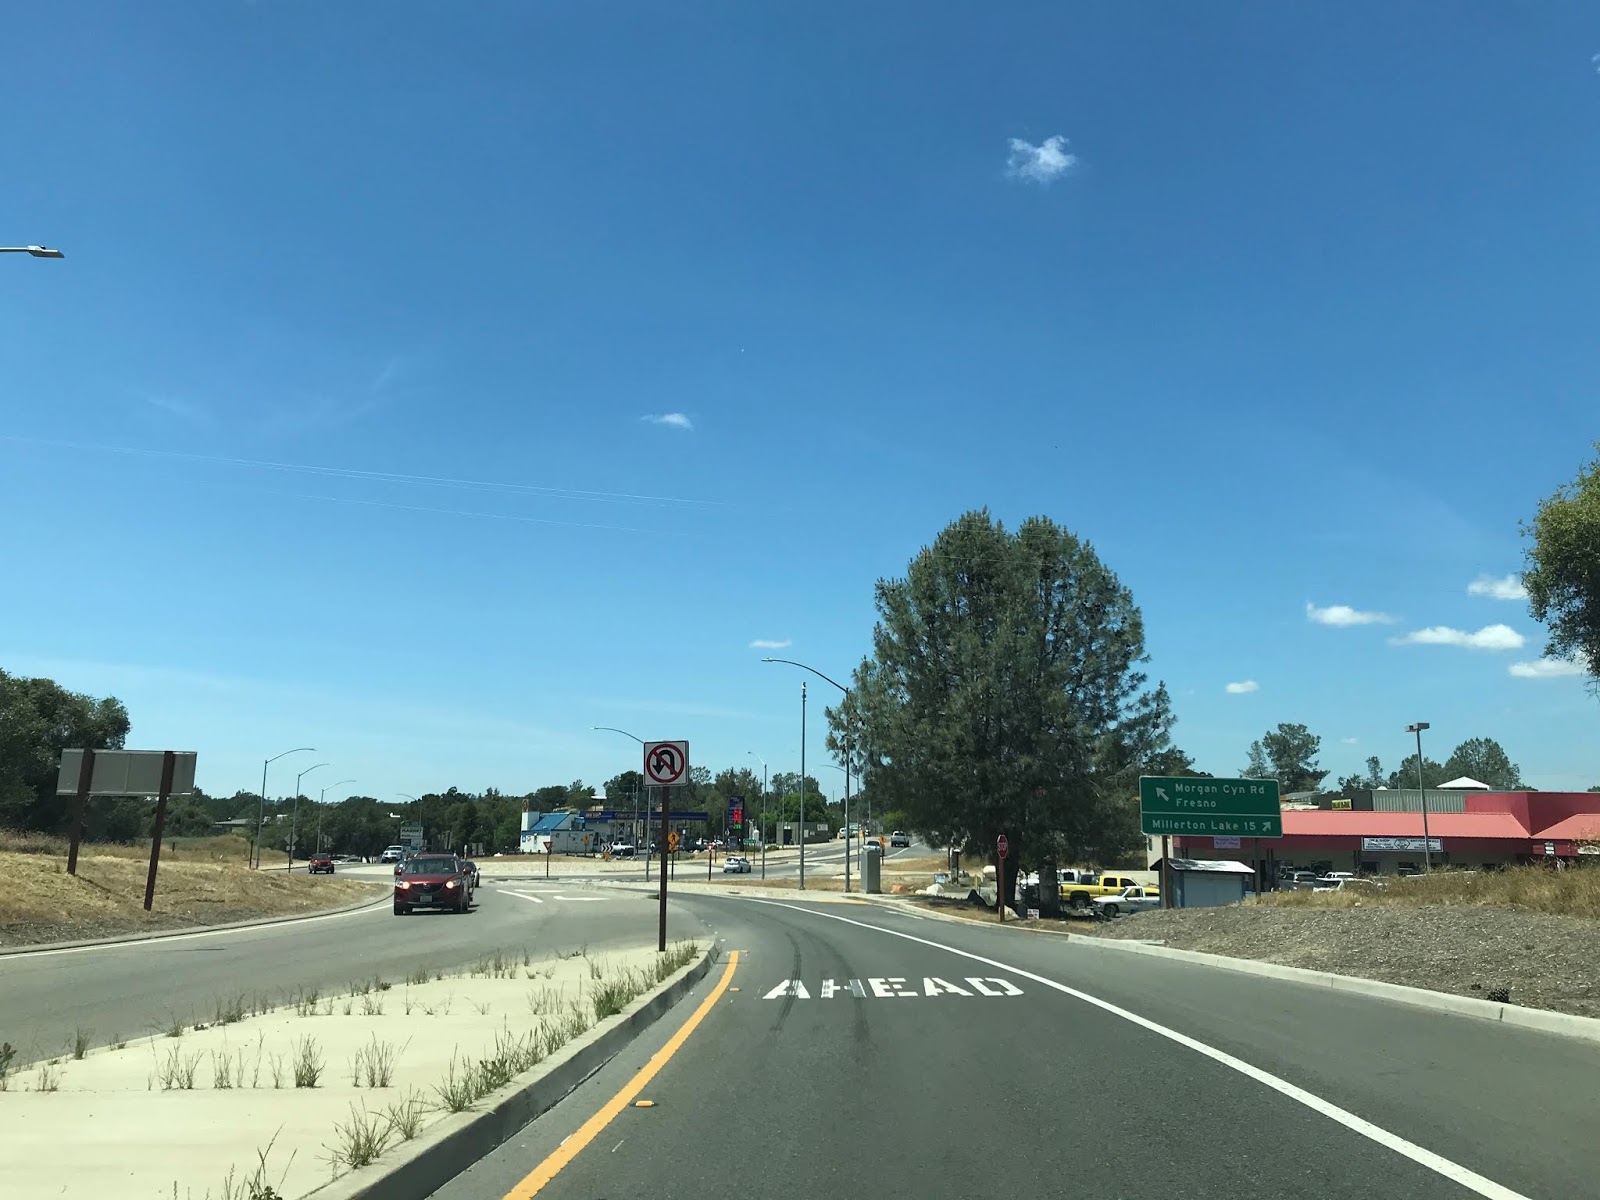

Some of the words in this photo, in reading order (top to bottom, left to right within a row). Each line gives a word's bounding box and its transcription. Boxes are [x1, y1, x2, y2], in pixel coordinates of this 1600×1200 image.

[1175, 783, 1218, 795] Morgan
[1223, 785, 1245, 796] Cyn
[1250, 785, 1265, 794] Rd
[1176, 798, 1217, 808] Fresno
[1152, 819, 1206, 830] Millerton
[1211, 821, 1239, 830] Lake
[1244, 822, 1256, 831] 15
[997, 842, 1008, 851] STOP
[762, 977, 1025, 999] AHEAD
